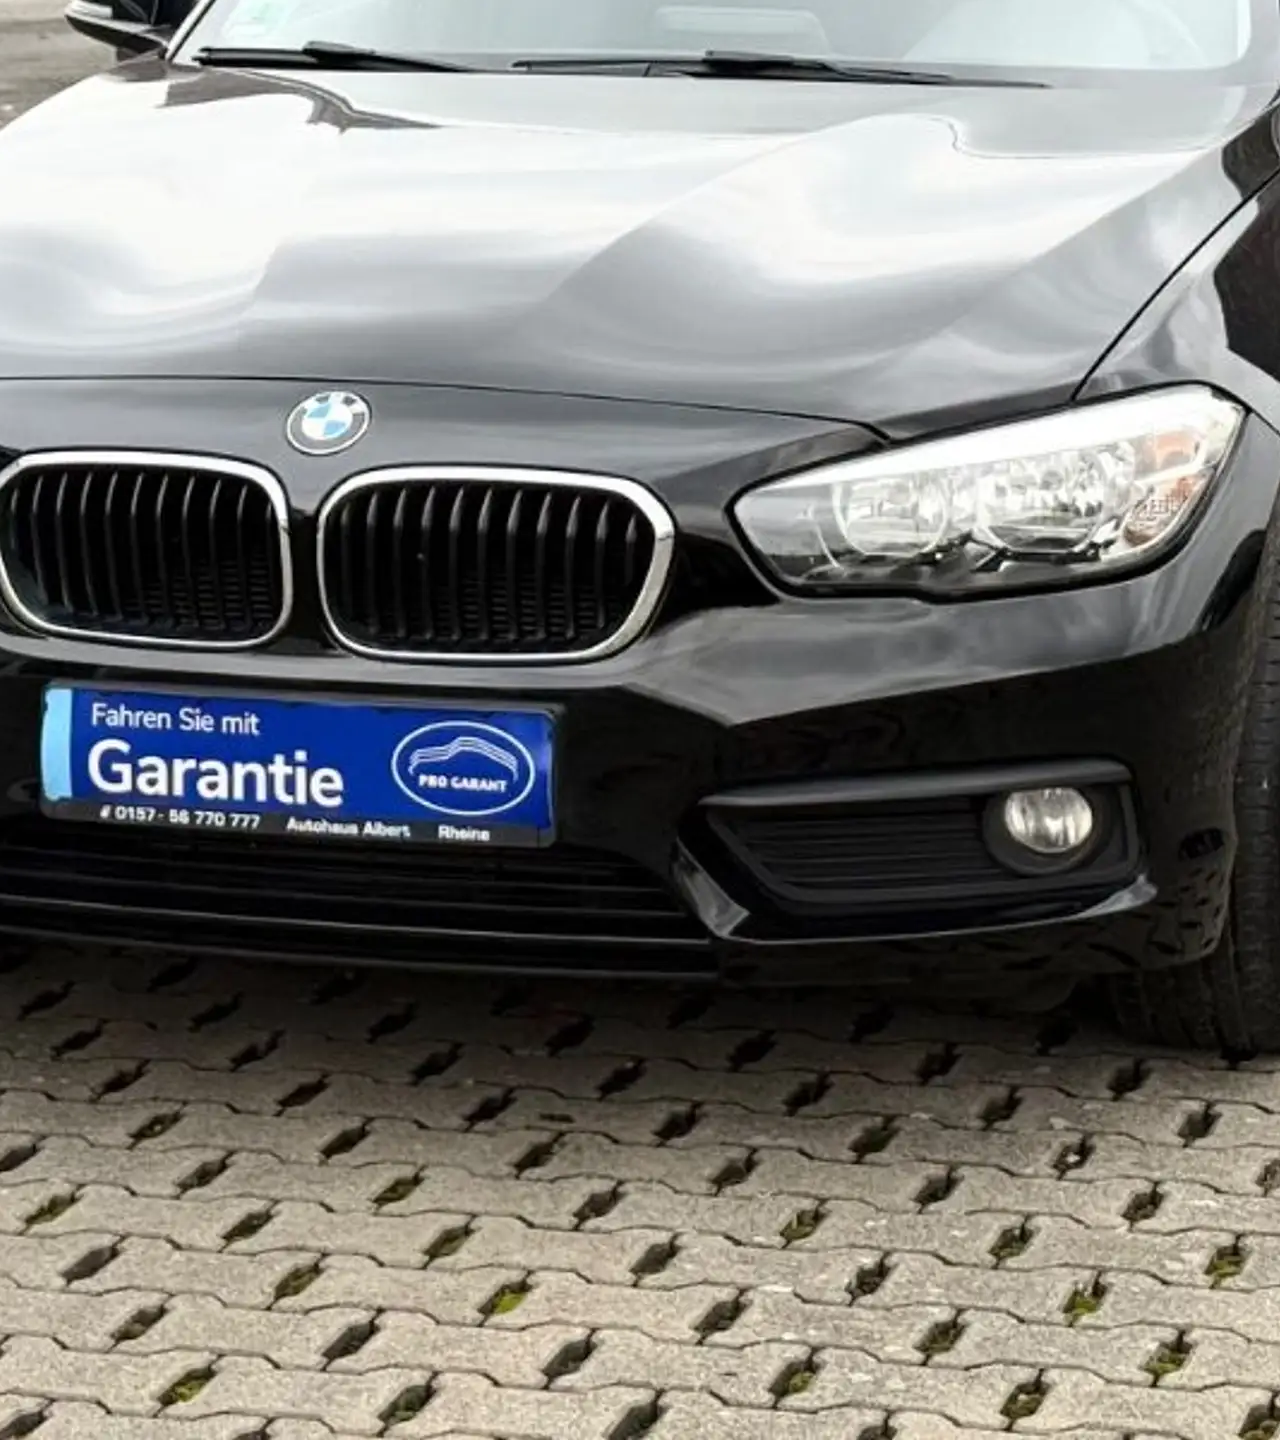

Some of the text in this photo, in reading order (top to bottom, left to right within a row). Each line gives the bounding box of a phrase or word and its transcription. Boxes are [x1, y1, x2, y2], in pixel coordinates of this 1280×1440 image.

[91, 702, 261, 736] Fahren Sie mit
[87, 738, 345, 807] Garantie
[418, 774, 508, 793] PRO GARANT
[194, 810, 226, 827] 770
[229, 813, 261, 830] 777
[286, 816, 411, 838] Autohaus Albert
[438, 824, 491, 842] Rheine
